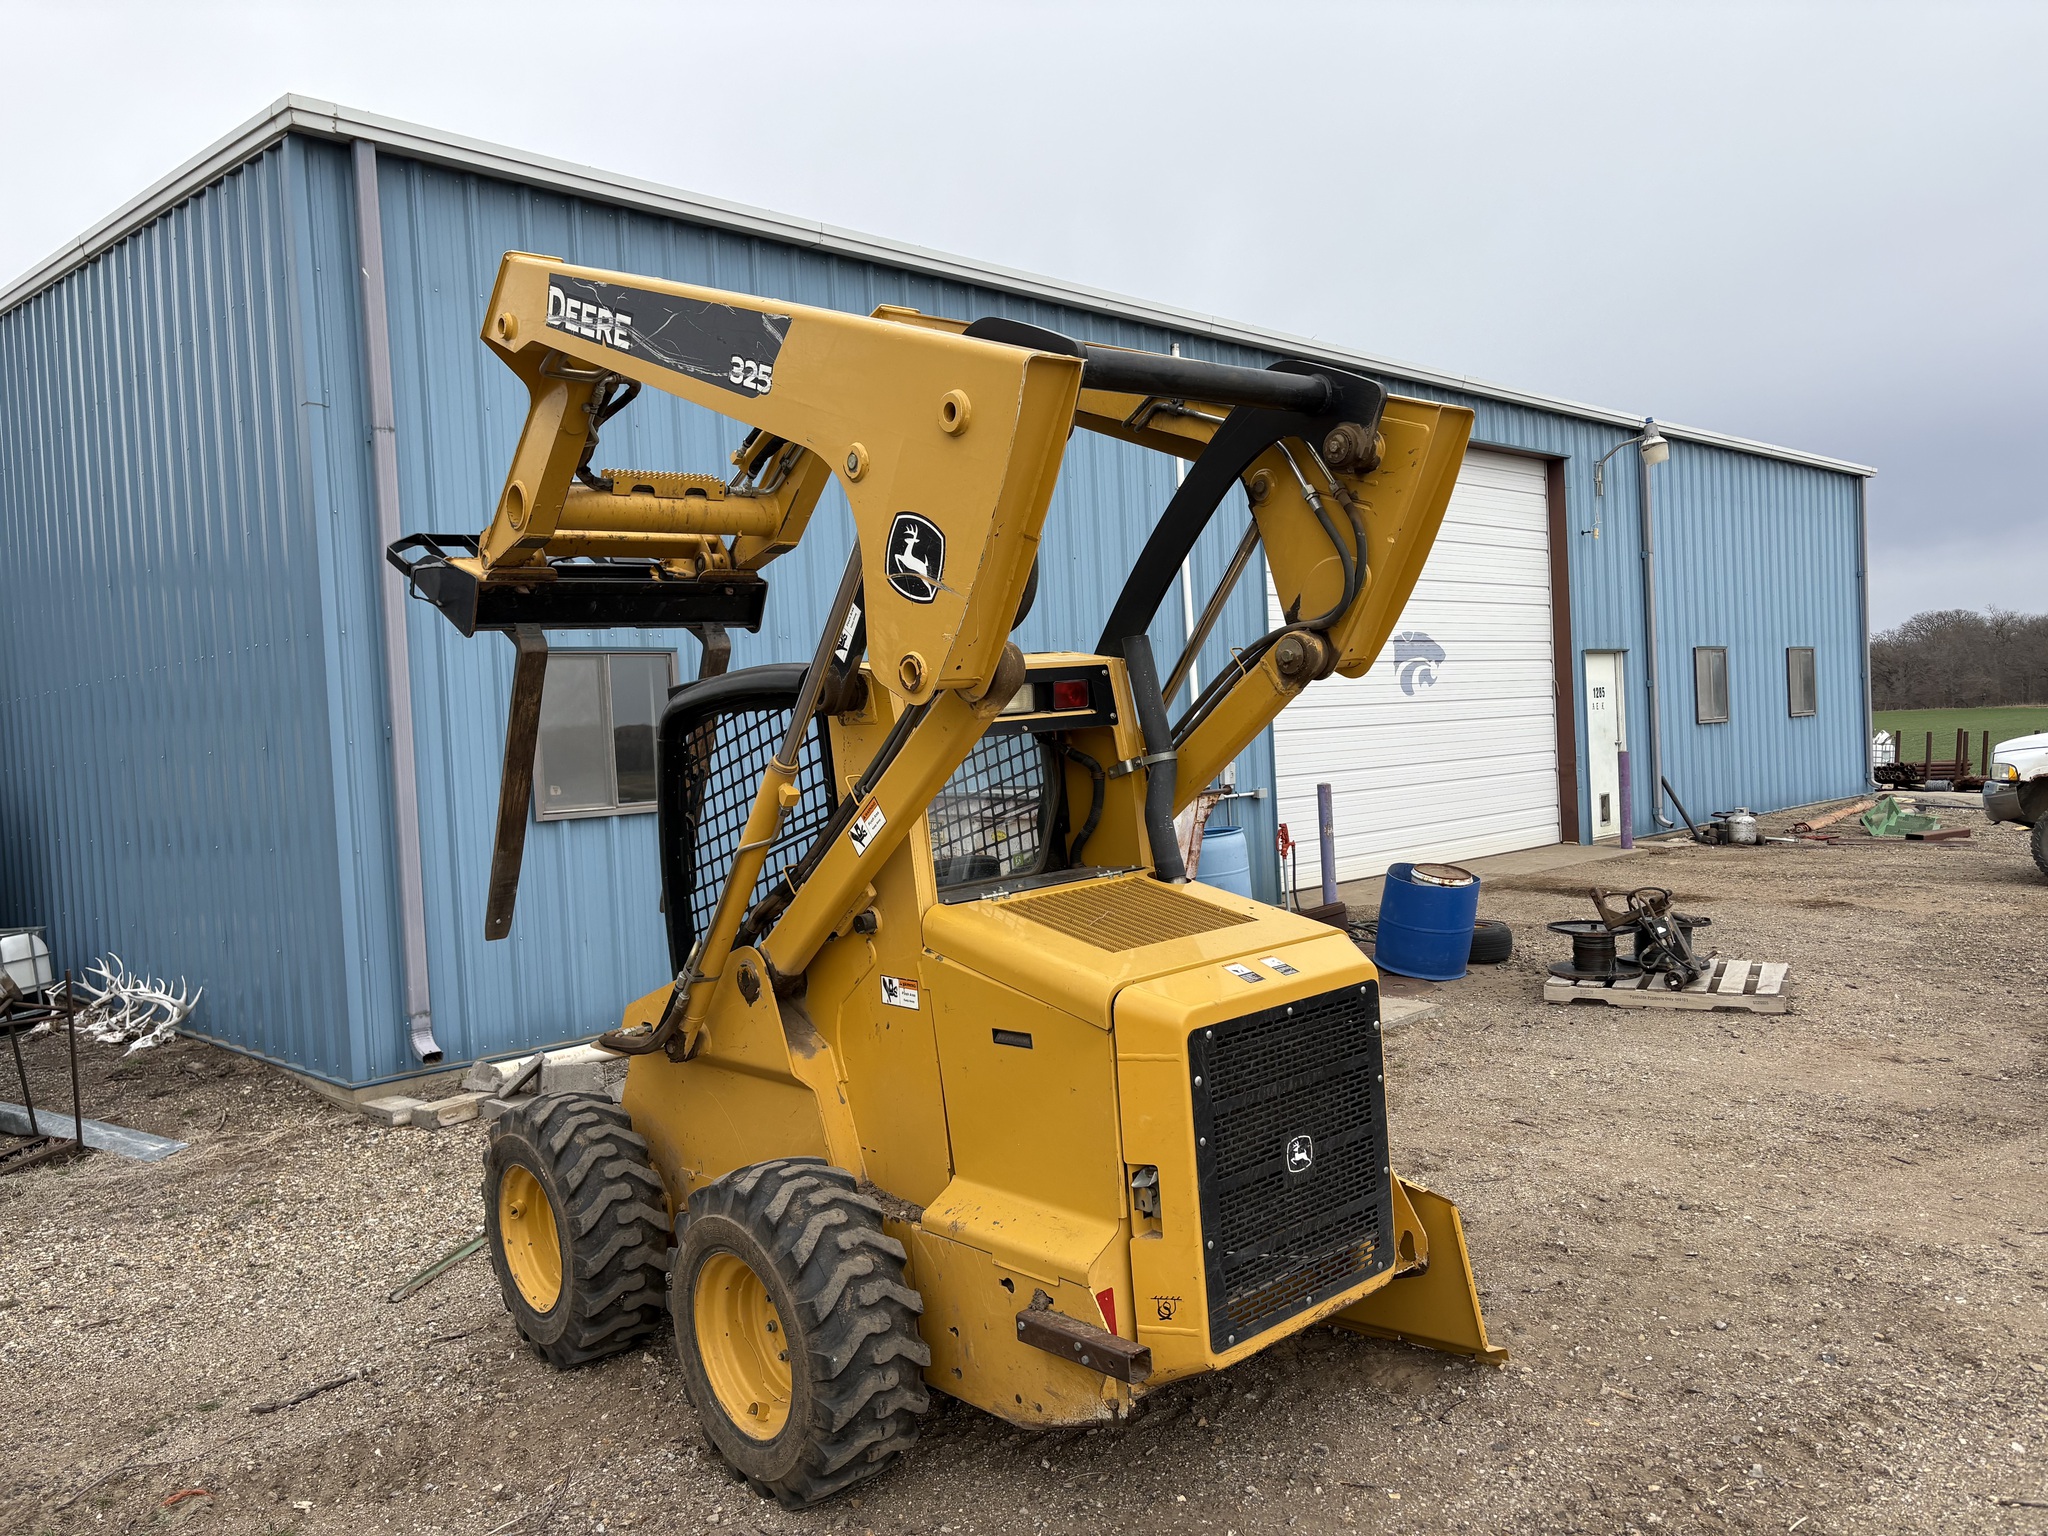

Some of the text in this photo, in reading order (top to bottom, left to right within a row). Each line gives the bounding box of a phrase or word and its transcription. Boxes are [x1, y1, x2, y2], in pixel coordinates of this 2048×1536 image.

[547, 286, 632, 349] DEERE
[730, 356, 773, 393] 325
[1593, 687, 1605, 698] 1285
